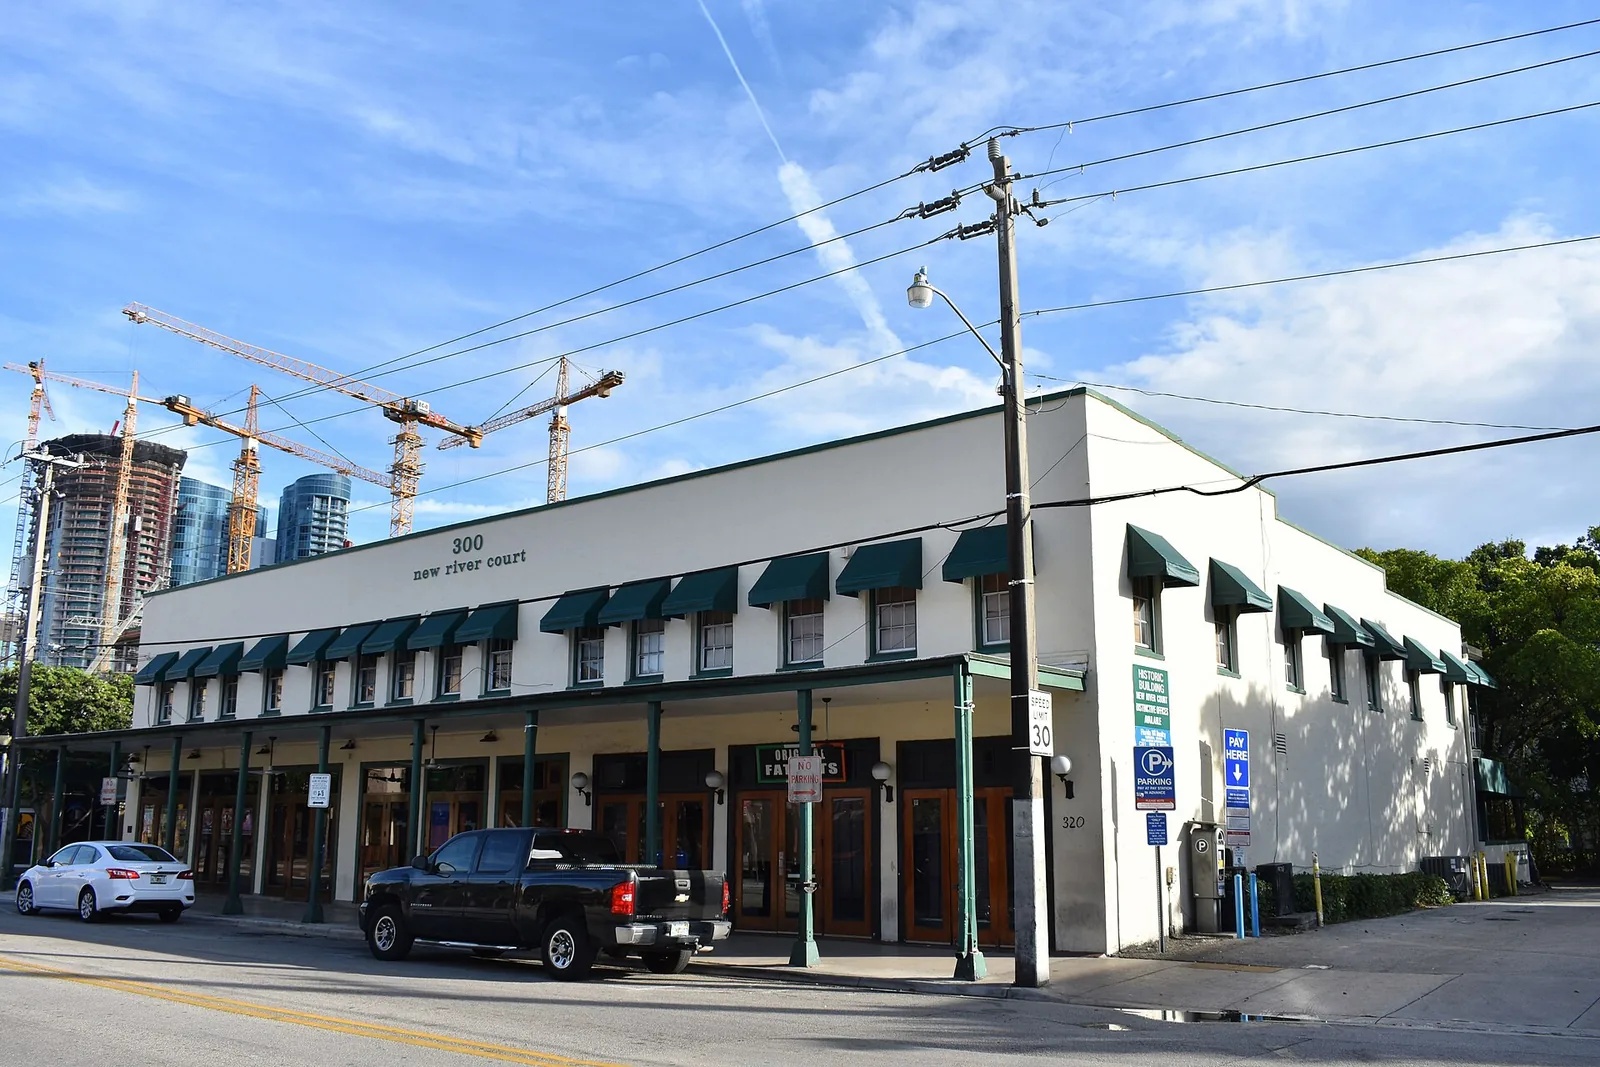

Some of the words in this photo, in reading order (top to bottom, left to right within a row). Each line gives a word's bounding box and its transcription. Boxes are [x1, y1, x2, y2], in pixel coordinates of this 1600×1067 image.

[453, 534, 484, 554] 300
[413, 567, 440, 580] new
[445, 560, 481, 575] river
[487, 549, 526, 568] court
[1138, 669, 1164, 682] HISTORIC
[1138, 680, 1165, 693] BUILDING
[1031, 696, 1049, 709] SPEED
[1033, 710, 1048, 721] LIMIT
[1033, 724, 1050, 747] 30
[1229, 736, 1244, 748] PAY
[775, 748, 825, 760] ORIGAL
[1226, 749, 1248, 760] HERE
[798, 762, 811, 770] NO
[1149, 754, 1162, 771] P
[791, 775, 819, 784] PARKING
[1137, 778, 1172, 786] PARKING
[1062, 816, 1085, 829] 320
